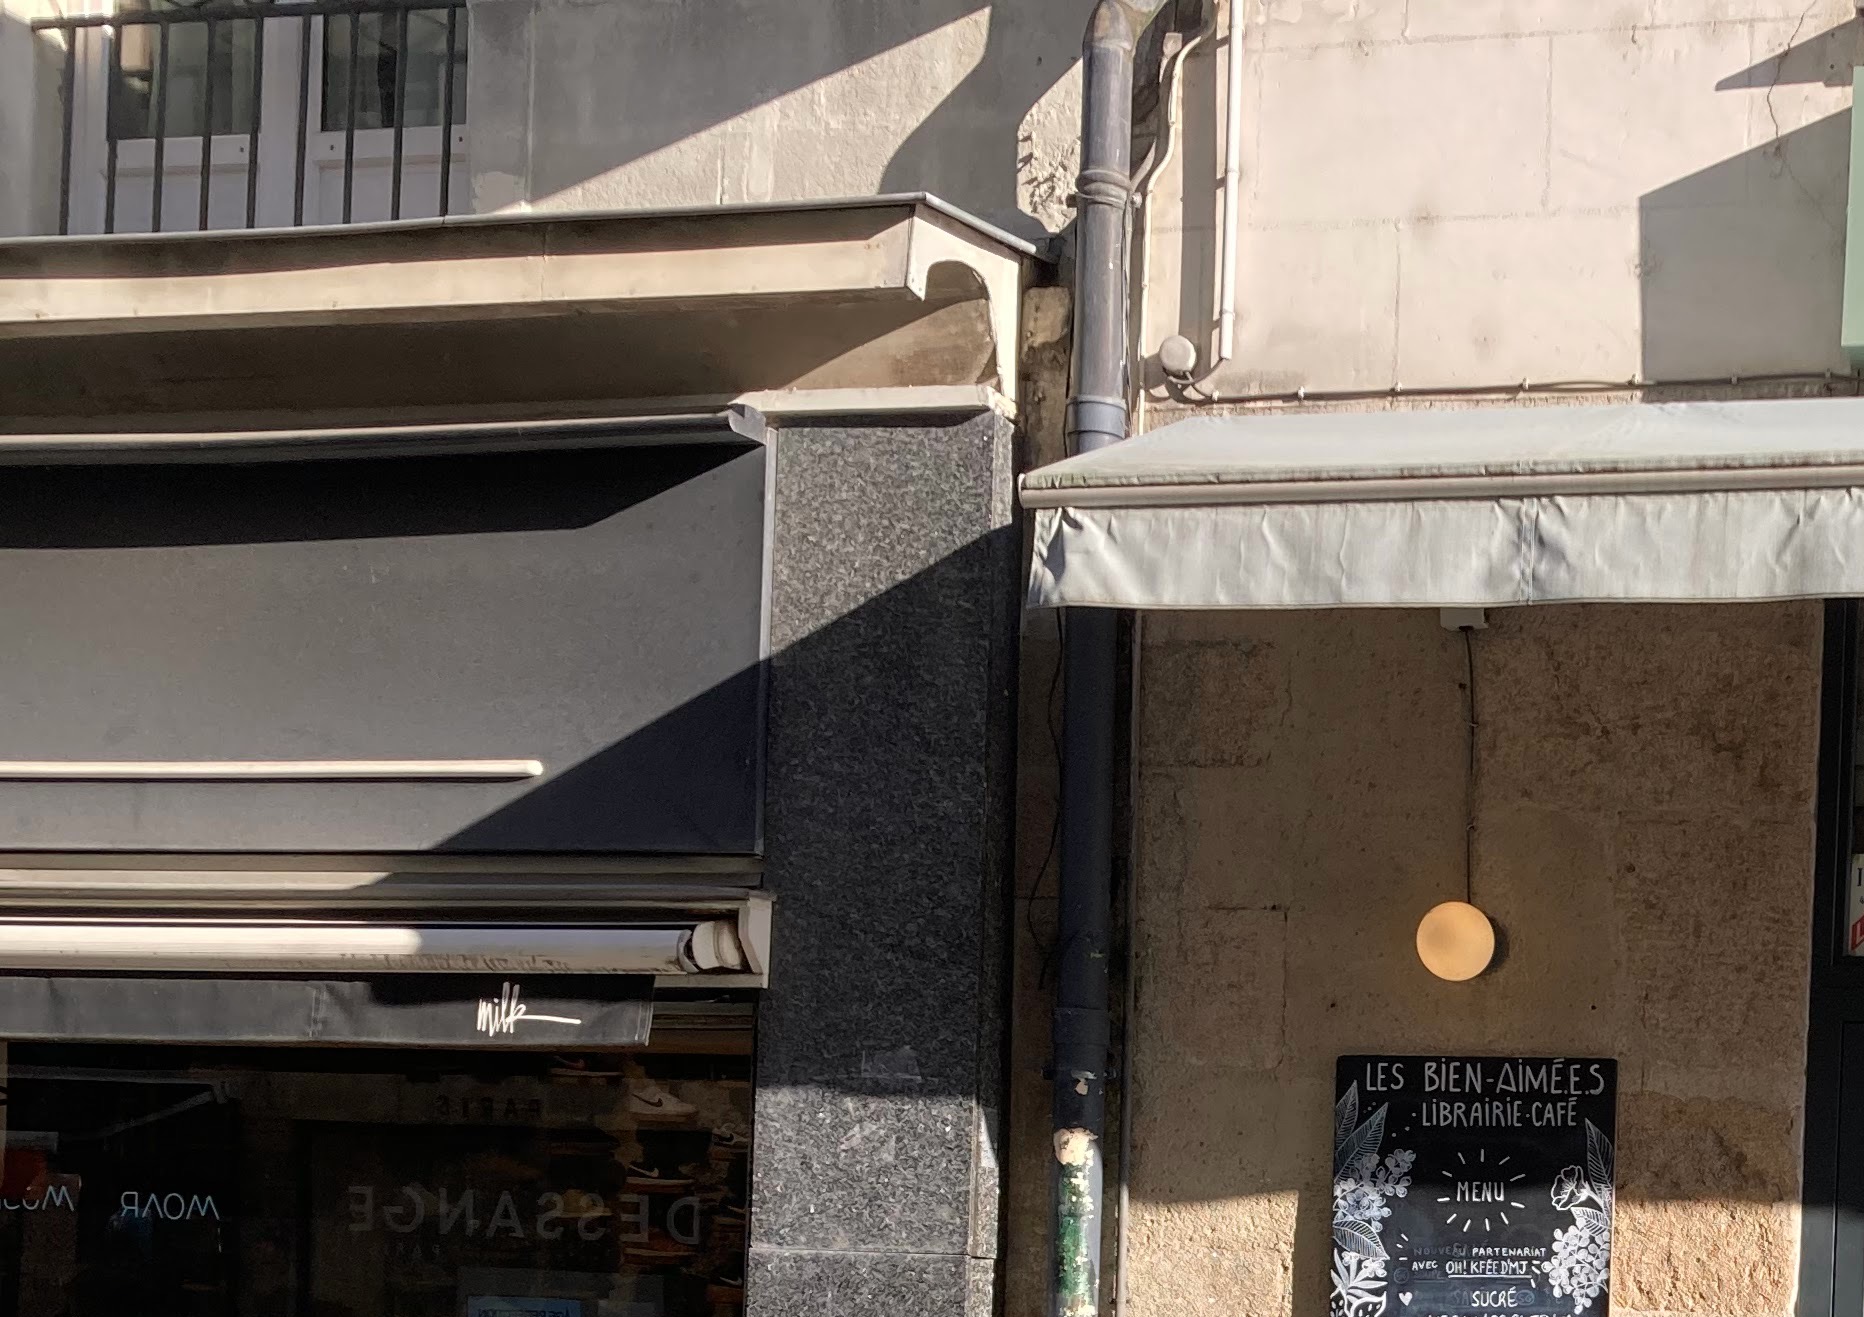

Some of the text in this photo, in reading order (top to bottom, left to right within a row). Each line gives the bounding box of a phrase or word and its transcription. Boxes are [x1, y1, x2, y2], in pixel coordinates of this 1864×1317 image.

[477, 982, 581, 1036] milk
[1366, 1062, 1405, 1092] LES
[1456, 1181, 1505, 1203] MENU
[1471, 1246, 1547, 1257] PARTENARIAT
[1411, 1260, 1439, 1272] AVEC
[1471, 1286, 1519, 1308] SUCRÉ
